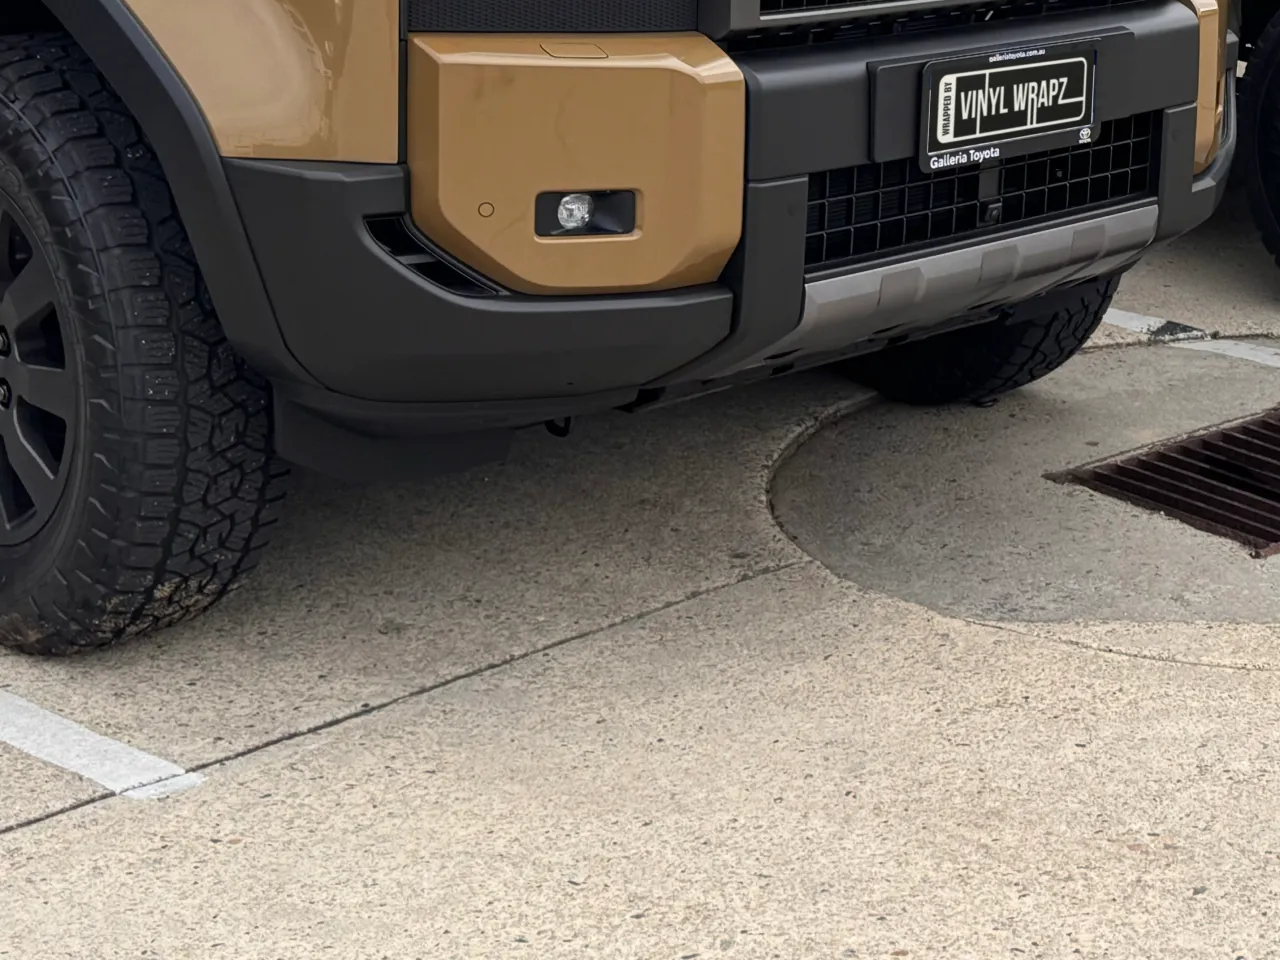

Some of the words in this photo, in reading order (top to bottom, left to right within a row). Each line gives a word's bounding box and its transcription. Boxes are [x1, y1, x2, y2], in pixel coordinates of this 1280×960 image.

[944, 82, 953, 93] BY
[942, 95, 952, 136] WRAPPED
[961, 78, 1008, 130] VINYL
[1013, 77, 1076, 122] WRAPZ
[930, 152, 967, 169] Galleria
[969, 147, 1000, 163] Toyota
